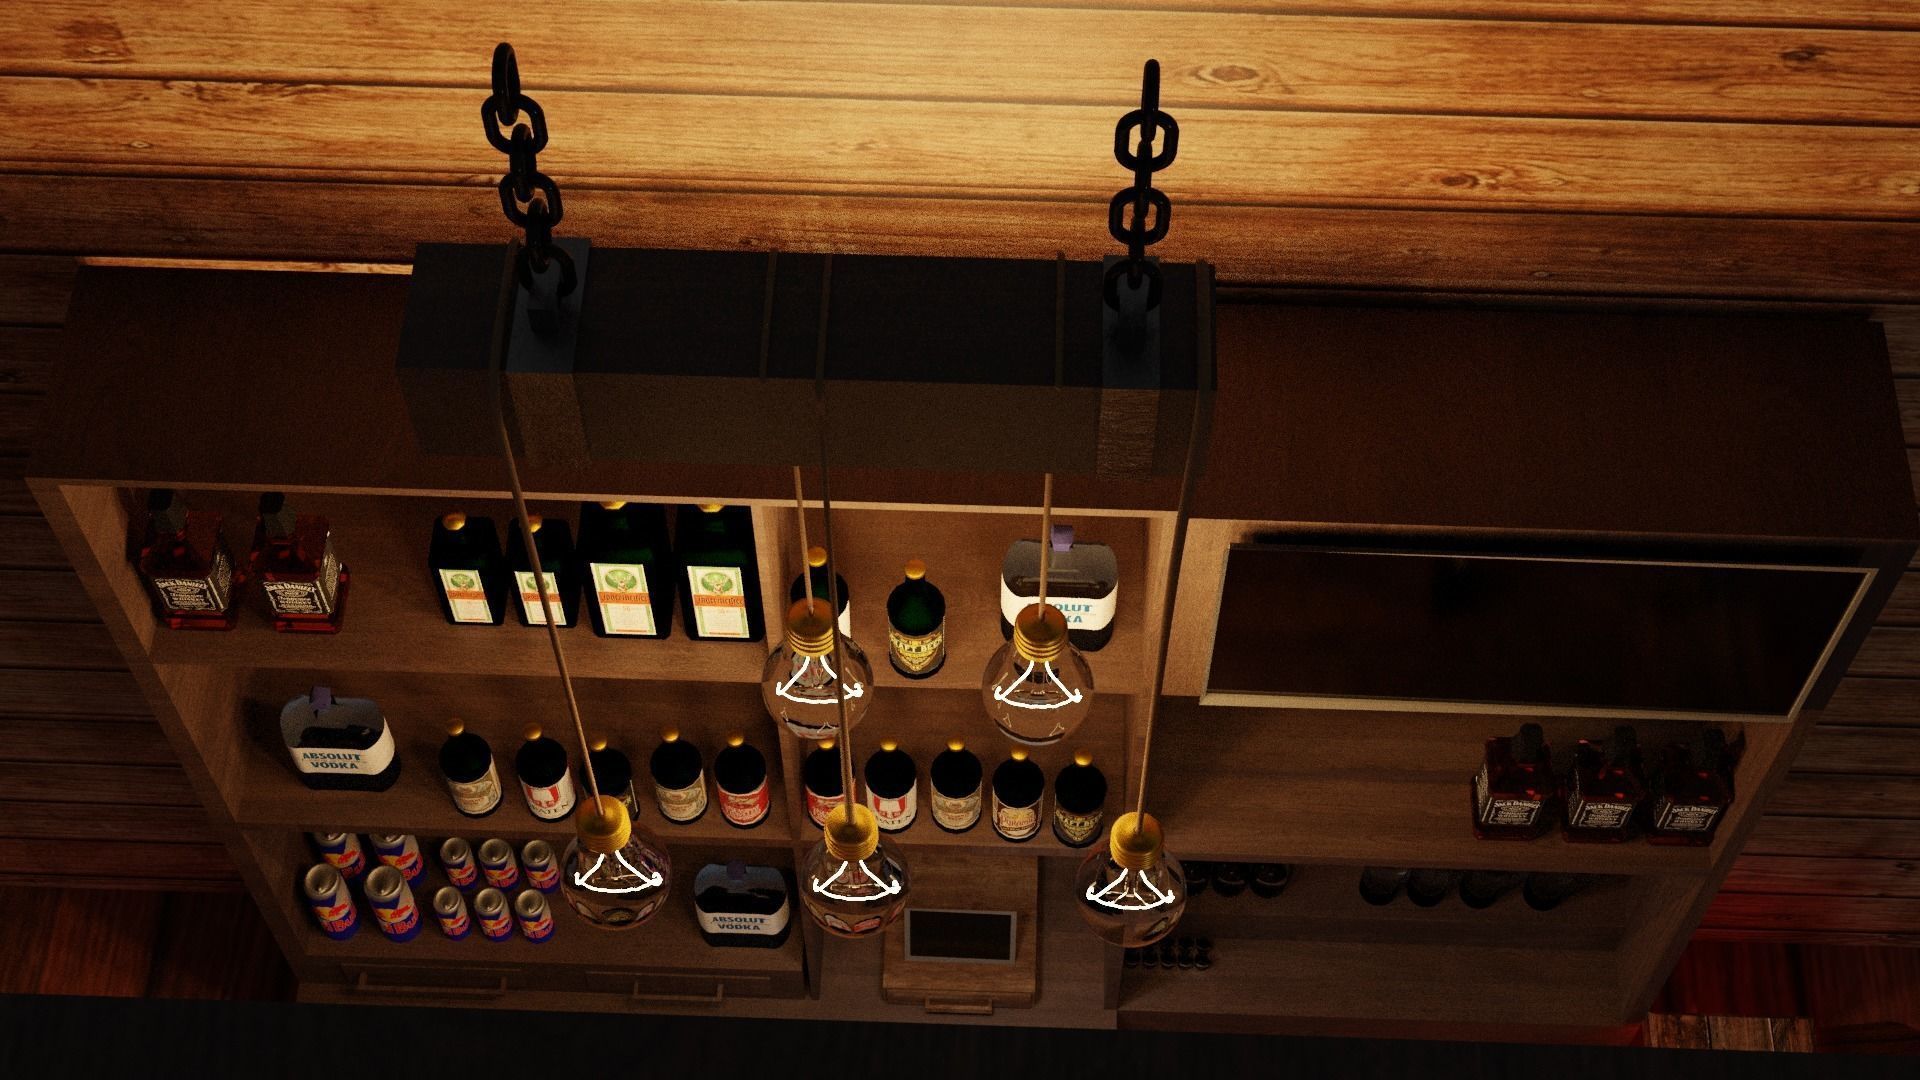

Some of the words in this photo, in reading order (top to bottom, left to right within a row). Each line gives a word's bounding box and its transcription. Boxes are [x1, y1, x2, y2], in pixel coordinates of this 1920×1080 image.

[302, 752, 361, 761] ABSOLUT
[311, 761, 358, 770] VODKA
[711, 916, 766, 924] ABSOLUT
[718, 923, 761, 931] VODKA
